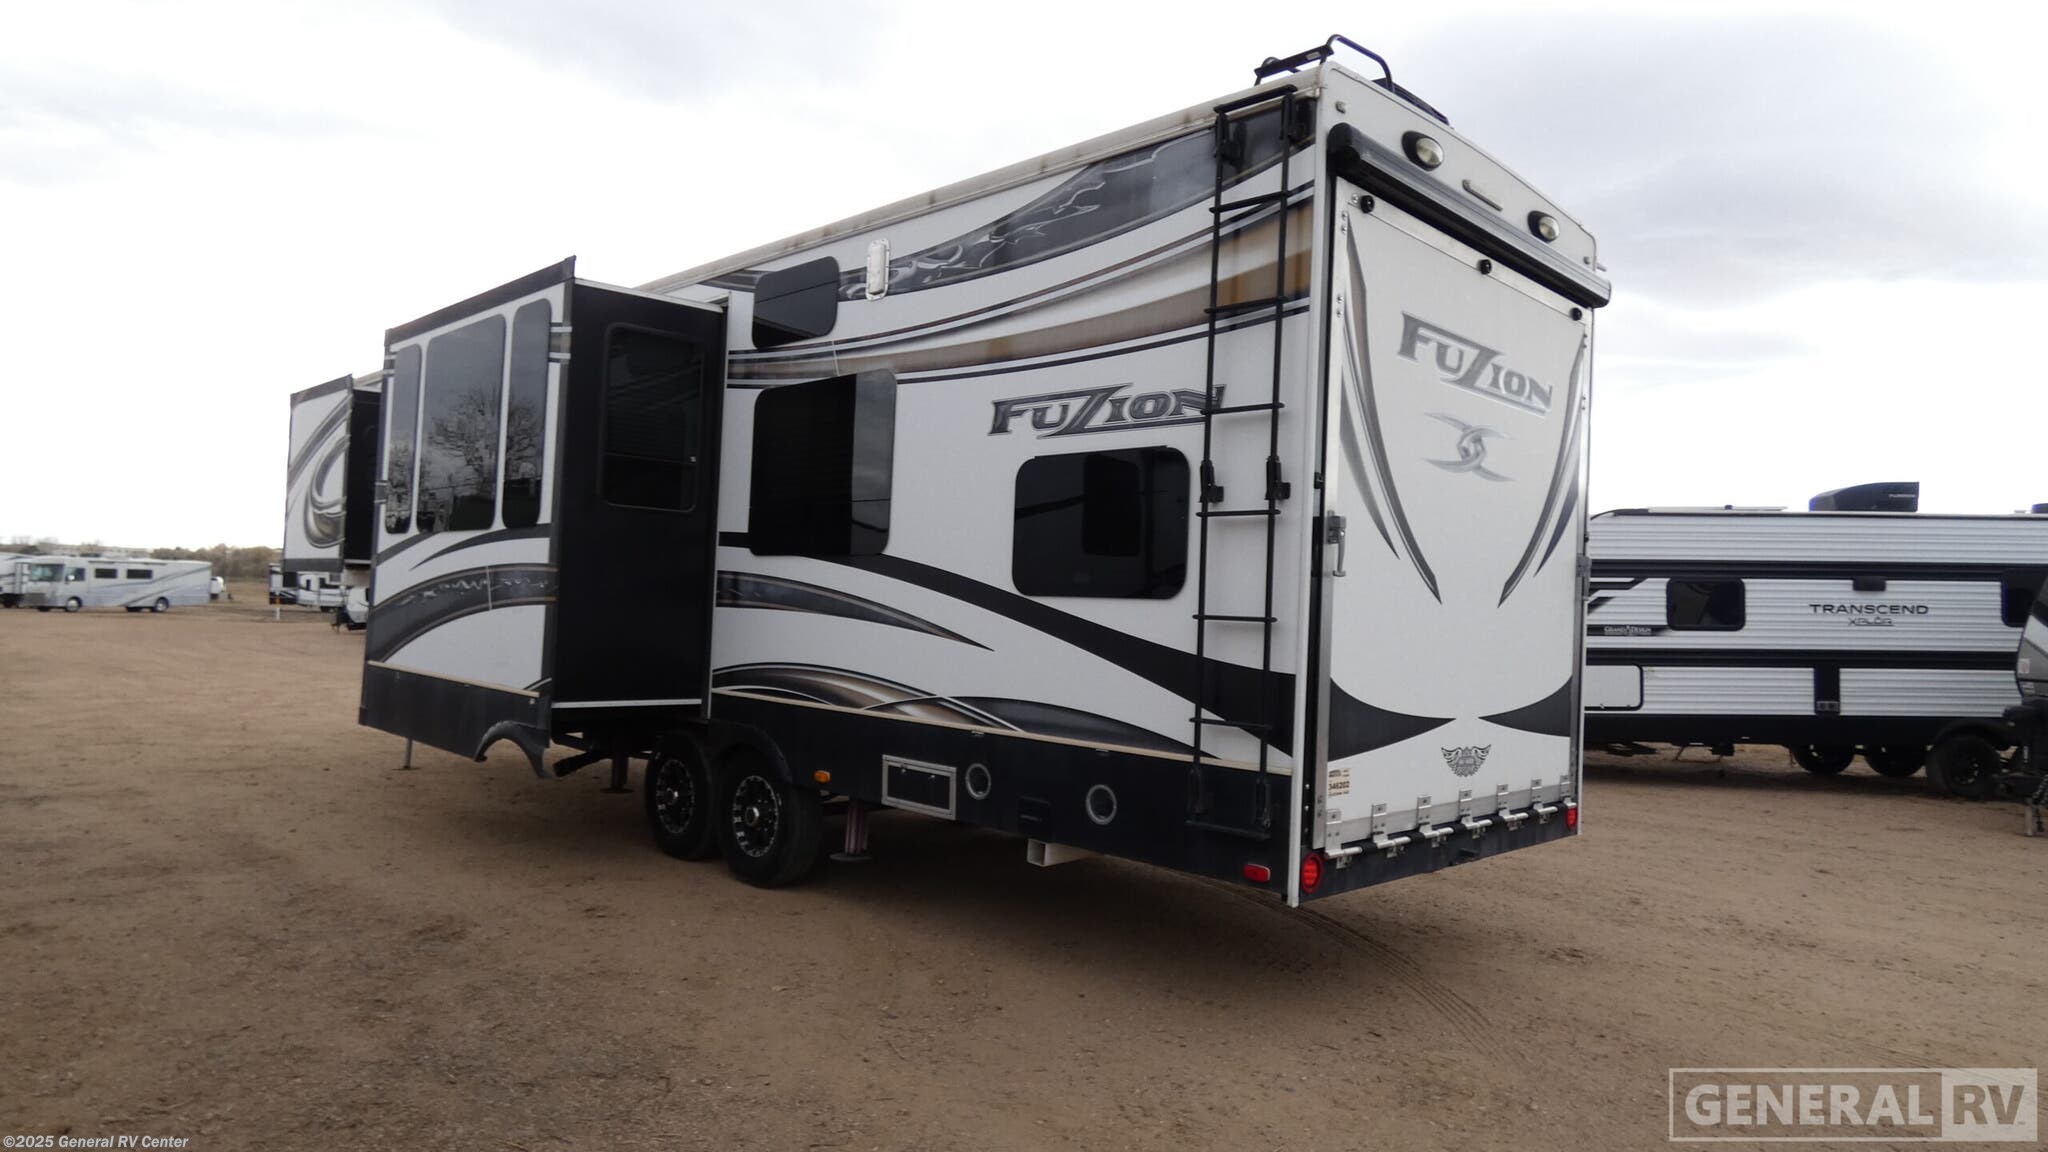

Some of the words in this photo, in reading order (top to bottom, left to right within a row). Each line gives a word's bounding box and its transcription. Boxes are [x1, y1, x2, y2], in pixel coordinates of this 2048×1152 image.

[1397, 310, 1552, 417] FUZION
[988, 383, 1226, 438] FUZION
[1809, 604, 1929, 615] TRANSCEND
